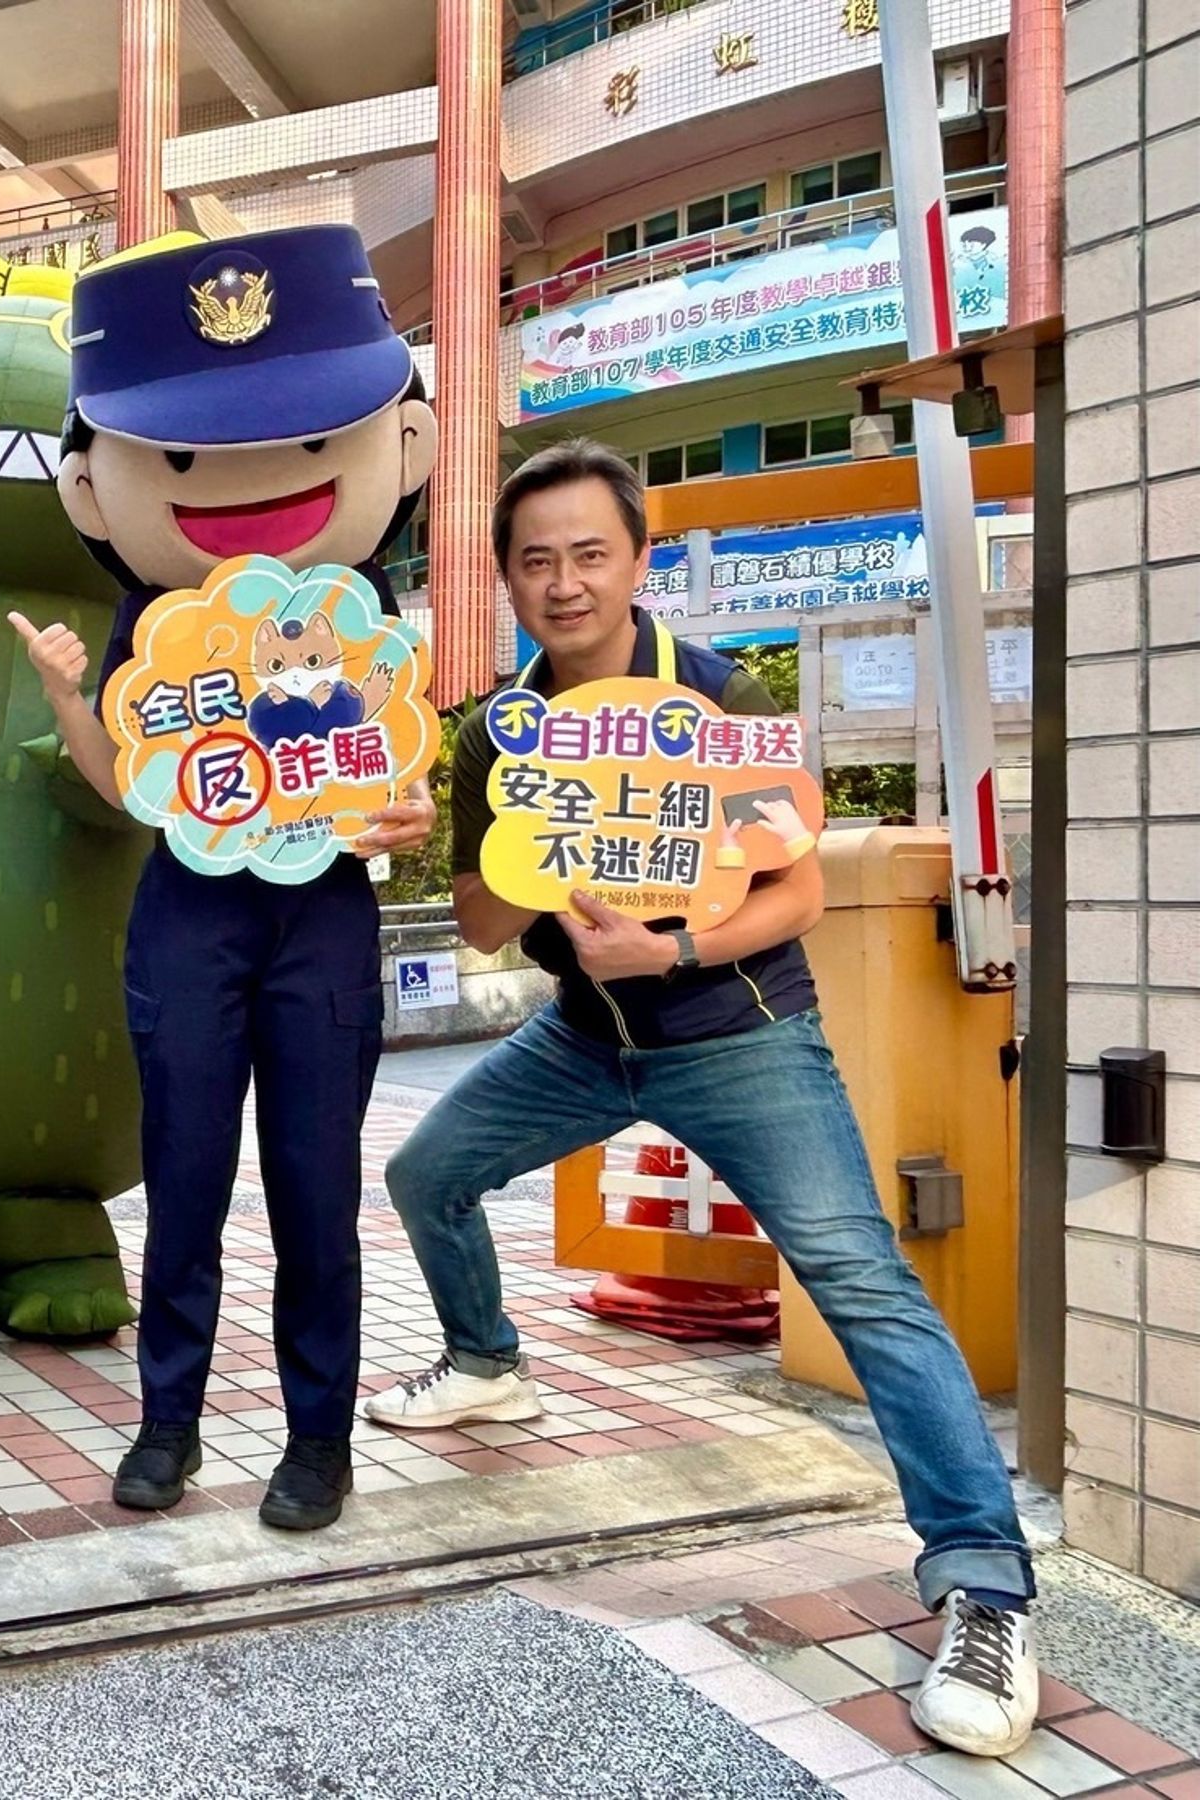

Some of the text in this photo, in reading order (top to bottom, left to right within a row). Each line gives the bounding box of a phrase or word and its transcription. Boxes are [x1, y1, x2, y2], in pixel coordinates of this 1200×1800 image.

[586, 257, 903, 354] 教育部105年度教學卓越銀
[530, 286, 990, 406] 教育部107學年度交通安全教育特校
[634, 542, 895, 597] 年度讀磐石績優學校
[138, 670, 247, 739] 全民
[493, 700, 800, 765] 不自拍不傳送
[499, 762, 713, 829] 安全上網
[532, 830, 703, 886] 不迷網
[588, 889, 692, 910] 北婦幼警察隊
